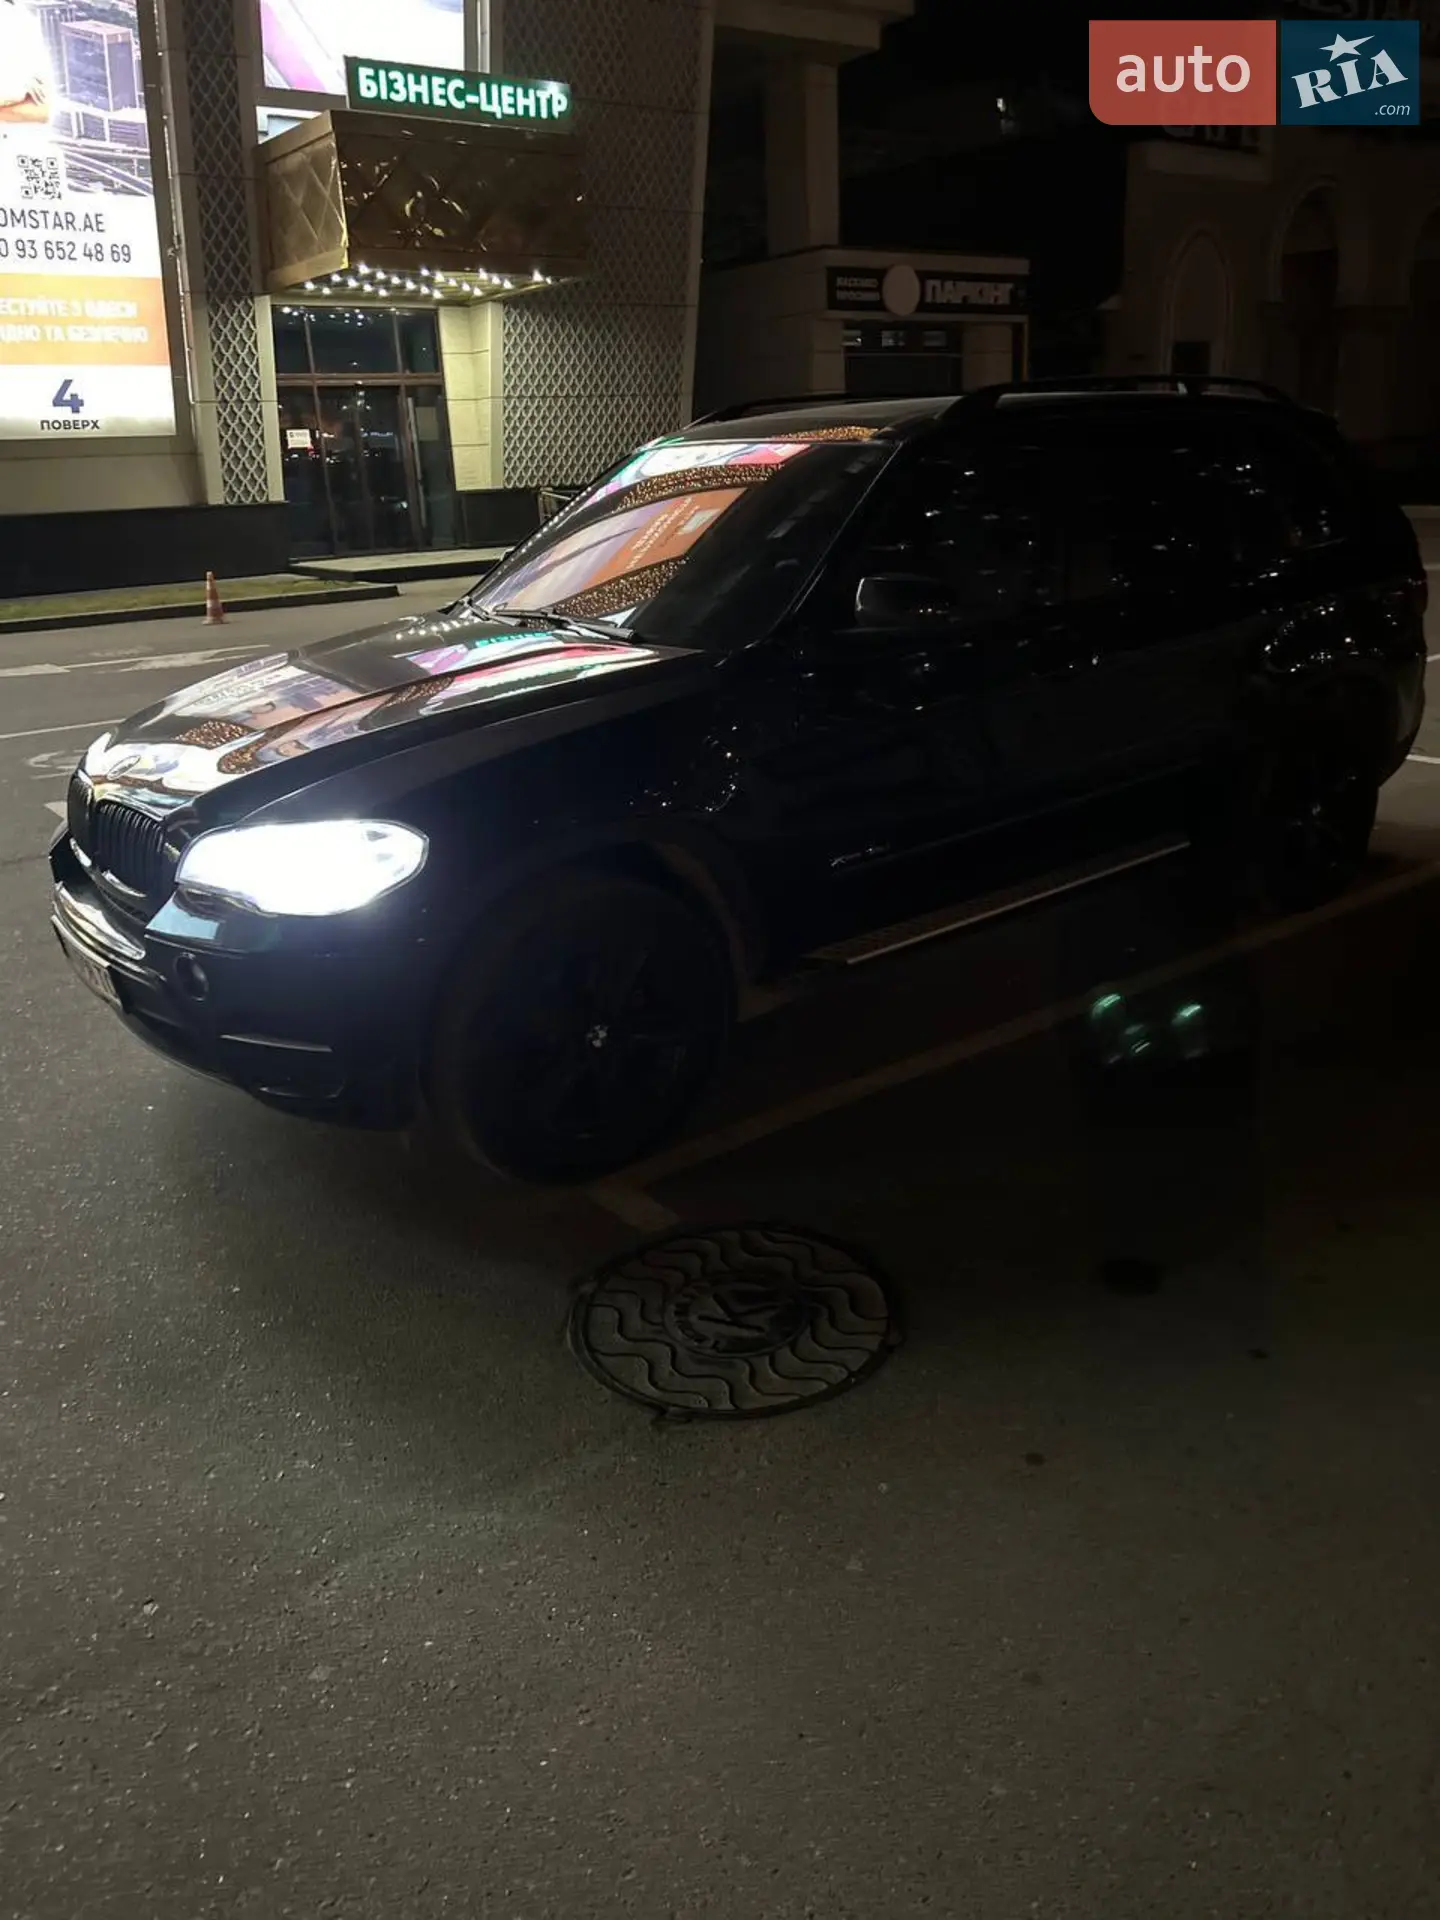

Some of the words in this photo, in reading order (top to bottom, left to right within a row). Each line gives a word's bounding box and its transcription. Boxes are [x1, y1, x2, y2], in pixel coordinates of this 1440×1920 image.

[358, 66, 568, 119] БІЗНЕС-ЦЕНТР
[15, 239, 38, 259] 93
[44, 240, 77, 261] 652
[83, 242, 104, 262] 48
[110, 244, 132, 263] 69
[52, 379, 85, 414] 4
[40, 419, 101, 431] ПОВЕРХ
